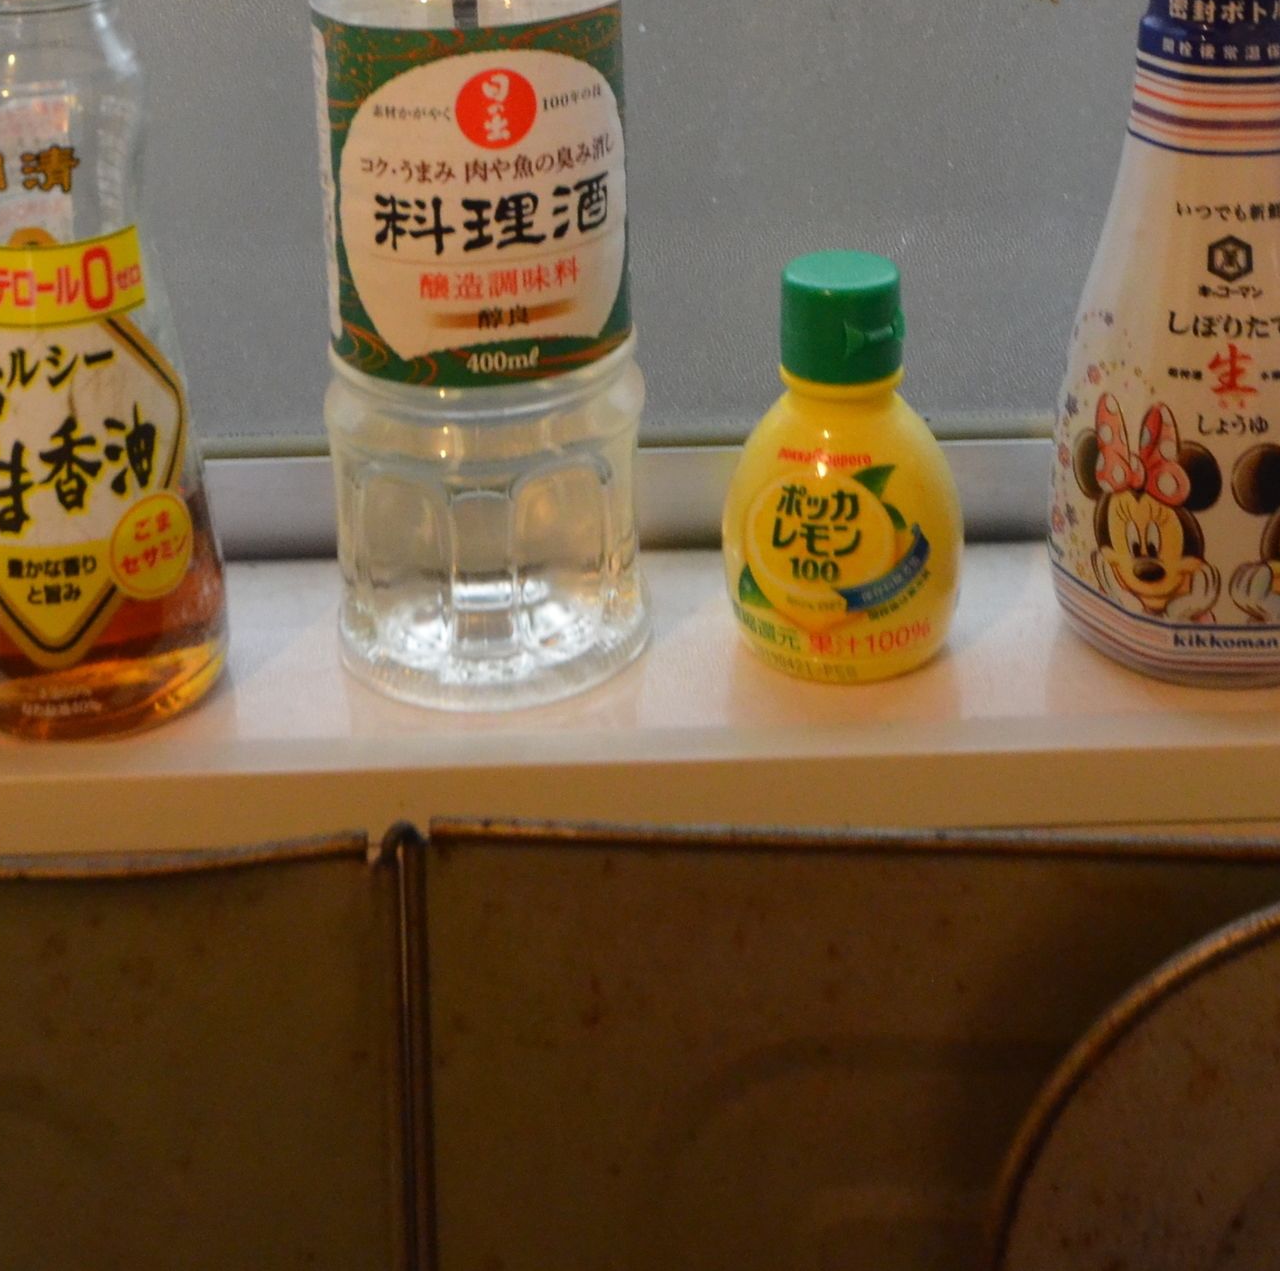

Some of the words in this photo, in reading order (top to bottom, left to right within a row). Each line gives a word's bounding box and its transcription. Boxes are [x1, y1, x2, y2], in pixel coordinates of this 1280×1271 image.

[374, 171, 609, 255] 料理酒
[420, 257, 580, 300] 醸造調味料
[1208, 343, 1258, 394] 生
[1198, 413, 1269, 436] しょうゆ
[777, 484, 860, 521] ポッカ
[772, 518, 862, 557] レモン
[789, 557, 840, 582] 100
[1173, 633, 1280, 649] kikkoman
